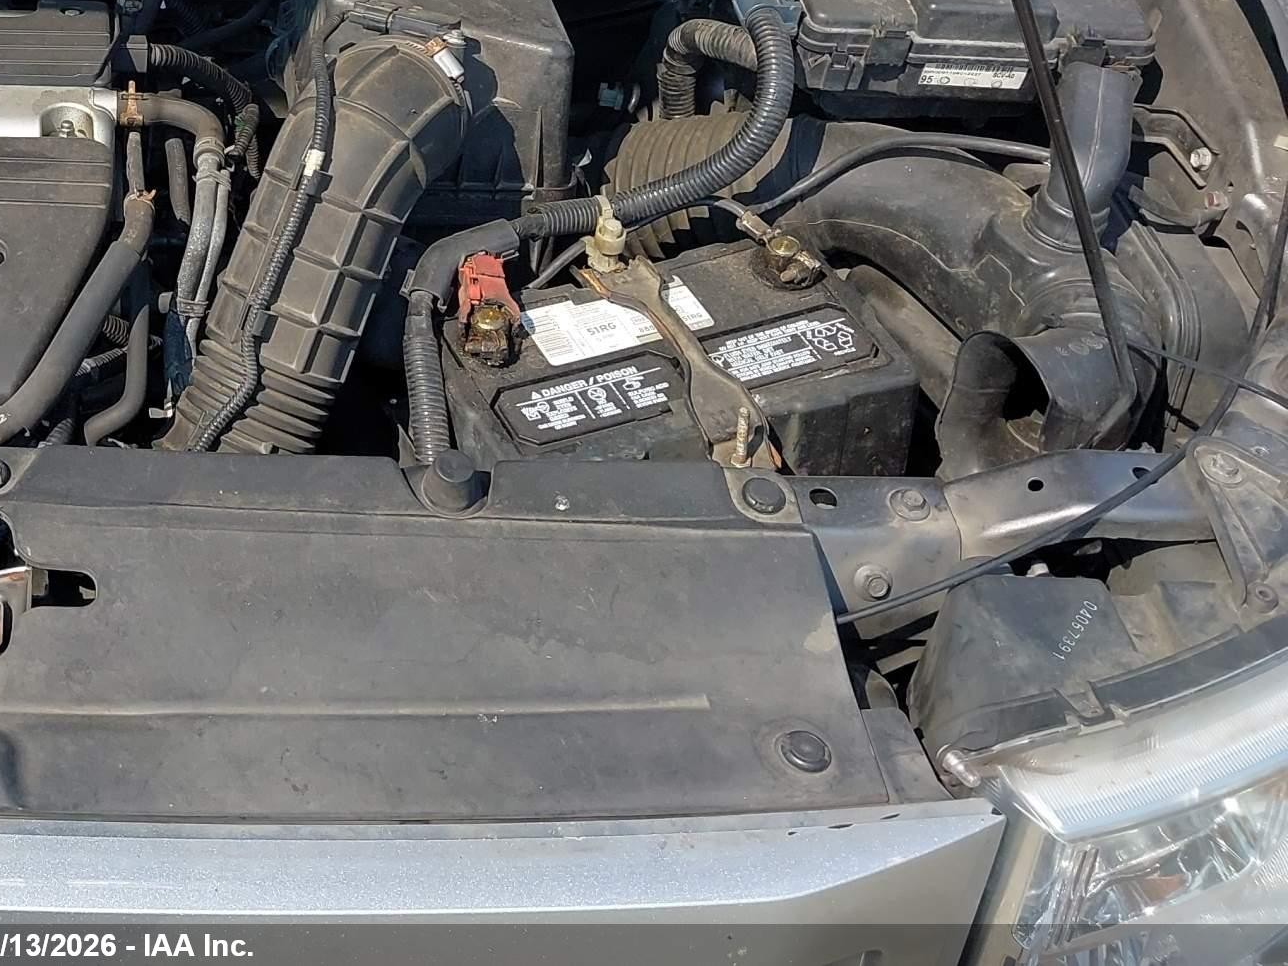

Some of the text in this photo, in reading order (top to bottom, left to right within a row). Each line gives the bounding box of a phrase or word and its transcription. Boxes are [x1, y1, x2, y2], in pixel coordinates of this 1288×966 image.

[920, 74, 934, 84] 95
[586, 322, 617, 336] 51RG
[541, 380, 588, 397] DANGER
[597, 365, 638, 383] POISON
[1051, 600, 1098, 661] 04067391
